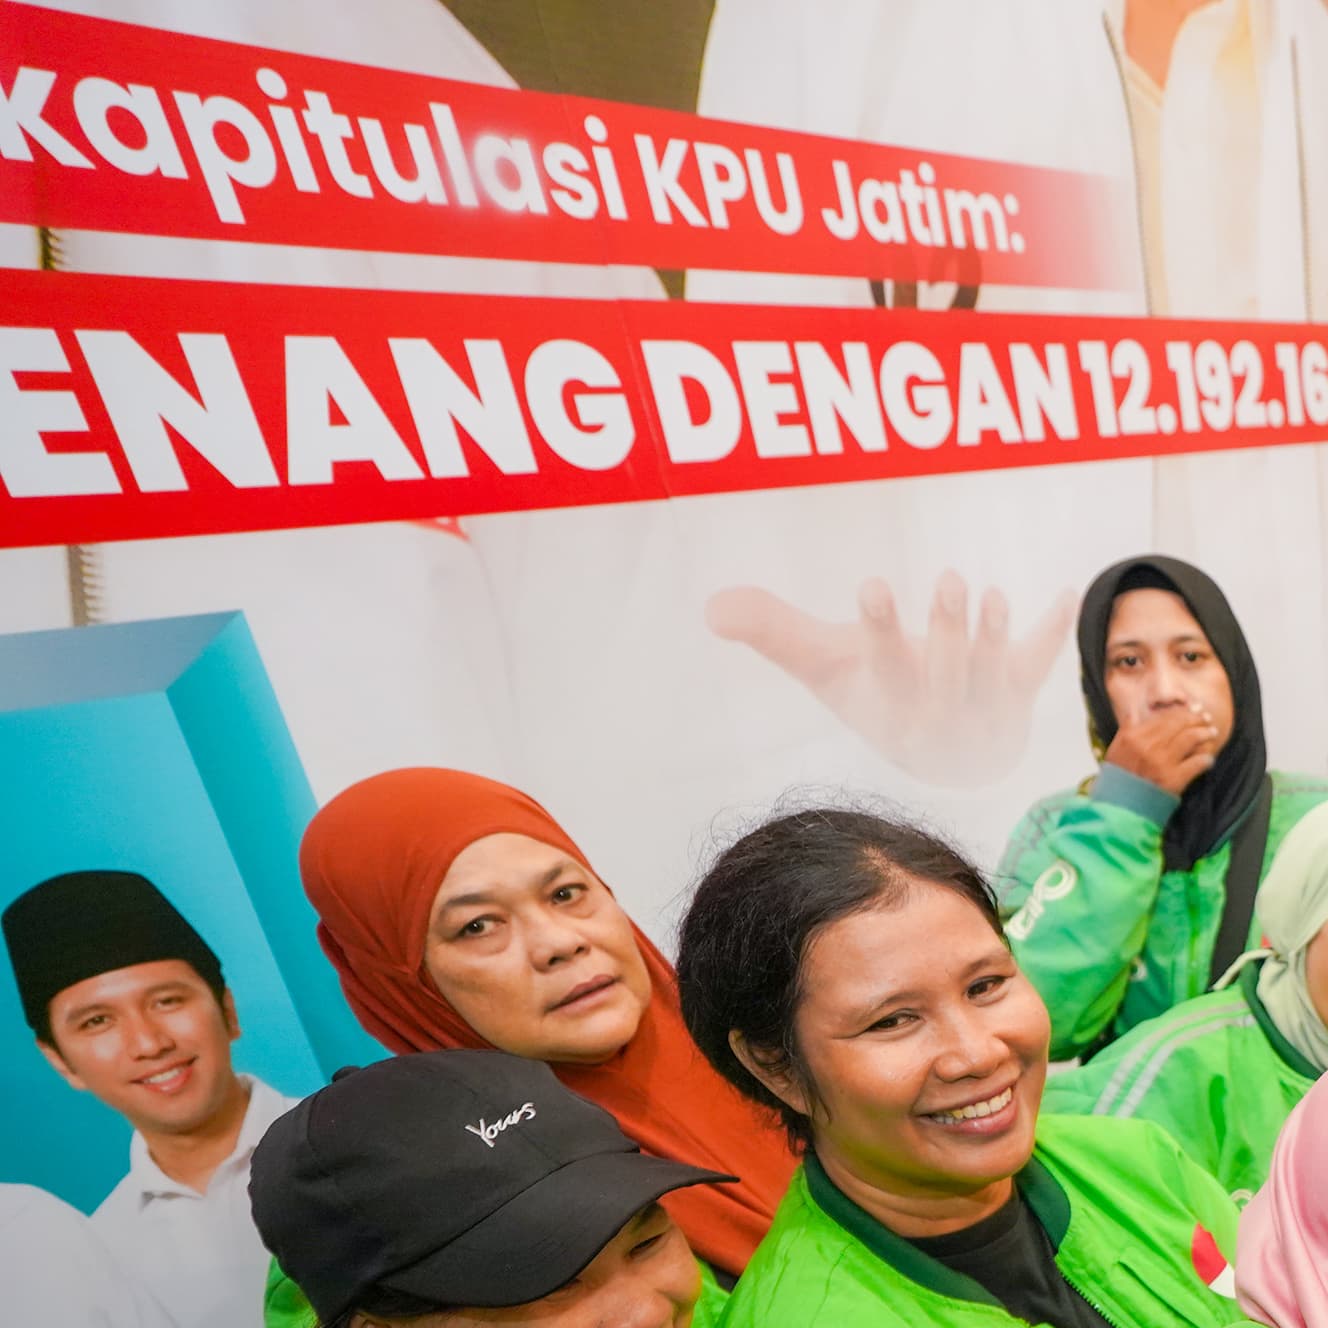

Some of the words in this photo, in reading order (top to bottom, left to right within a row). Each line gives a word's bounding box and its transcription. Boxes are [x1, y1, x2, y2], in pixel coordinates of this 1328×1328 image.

[634, 133, 801, 236] KPU
[821, 159, 1025, 253] Jatim:
[641, 340, 1079, 463] DENGAN
[464, 1102, 537, 1148] Yours
